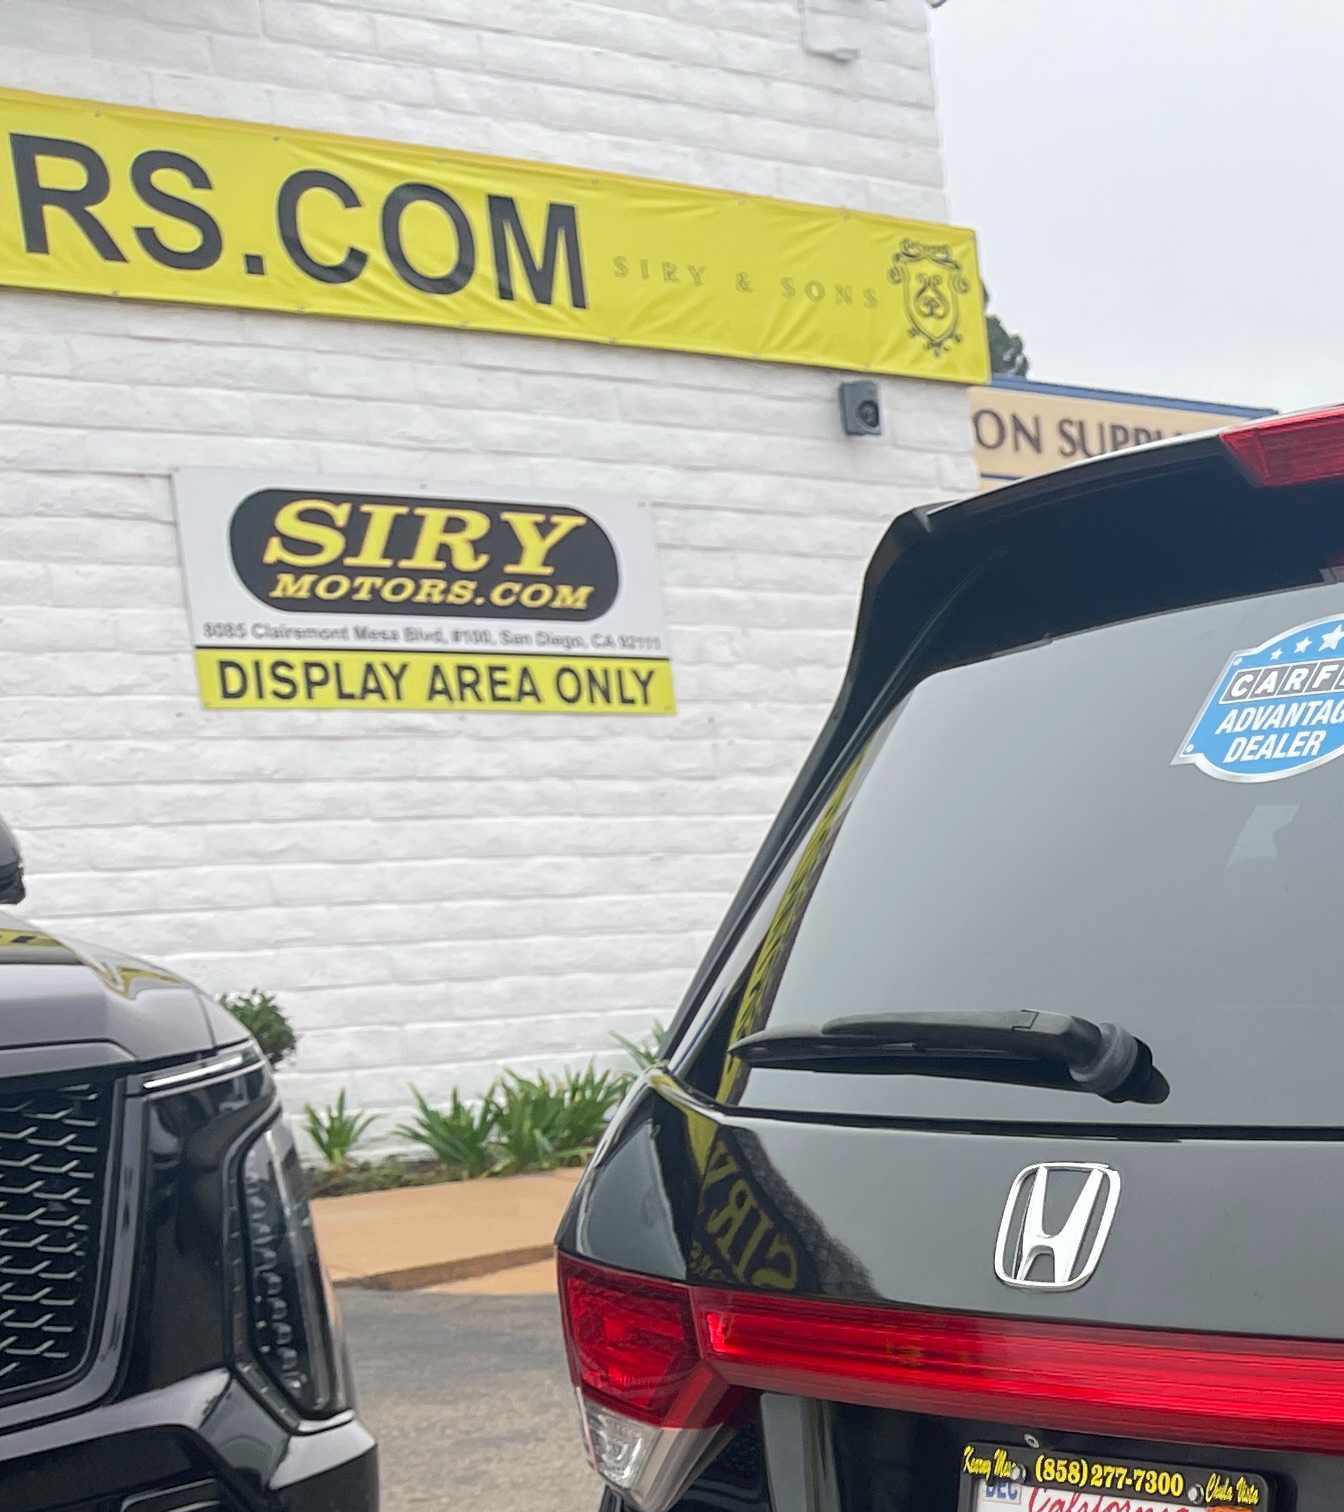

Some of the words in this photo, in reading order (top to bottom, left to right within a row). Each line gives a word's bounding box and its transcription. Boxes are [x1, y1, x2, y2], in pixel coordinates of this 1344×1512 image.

[9, 132, 589, 310] RS.COM
[613, 255, 705, 288] SIRY
[735, 273, 754, 294] &
[780, 277, 879, 309] SONS
[262, 498, 587, 577] SIRY
[269, 573, 594, 609] MOTORS.COM
[217, 659, 409, 702] DISPLAY
[427, 663, 546, 703] AREA
[555, 667, 656, 705] ONLY
[1223, 730, 1327, 763] DEALER
[1090, 1464, 1184, 1497] 277-7300
